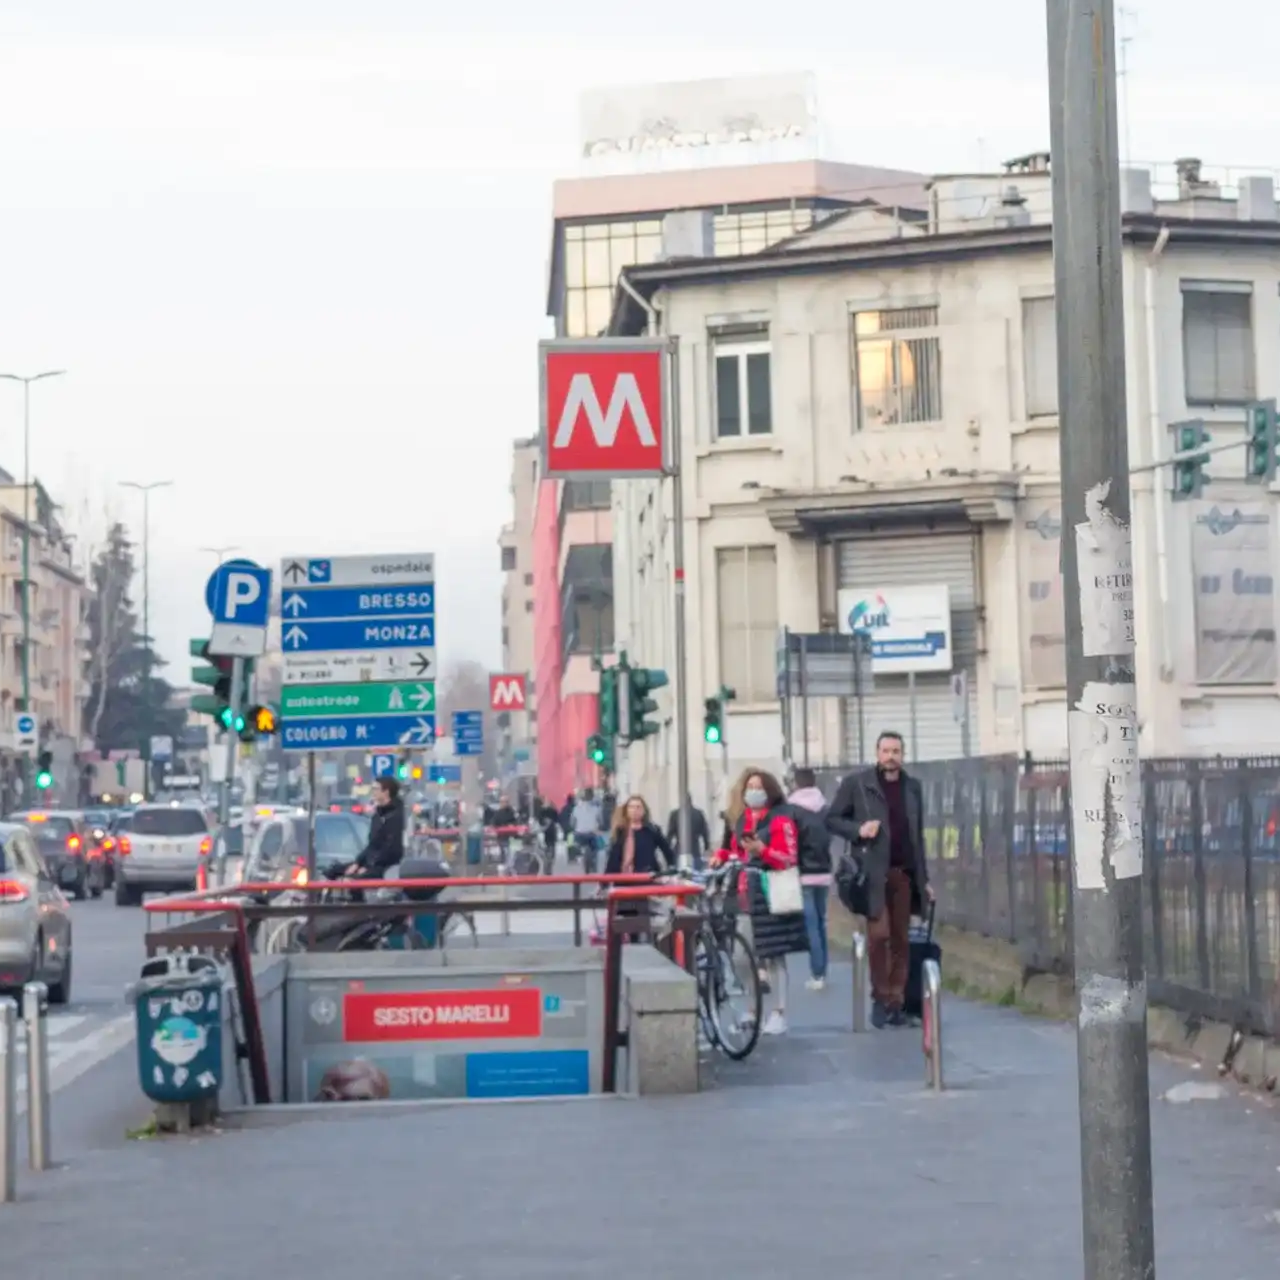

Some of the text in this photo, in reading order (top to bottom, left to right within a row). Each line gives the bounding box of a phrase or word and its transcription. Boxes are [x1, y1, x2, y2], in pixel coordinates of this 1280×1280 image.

[553, 372, 658, 448] M
[371, 560, 432, 575] ospedale
[225, 573, 261, 618] P
[359, 592, 431, 609] BRESSO
[364, 625, 431, 641] MONZA
[286, 695, 360, 708] autostrade
[493, 680, 524, 705] M
[285, 725, 348, 742] COLOGNO
[376, 755, 391, 776] P
[373, 1004, 510, 1026] SESTO MARELLI
